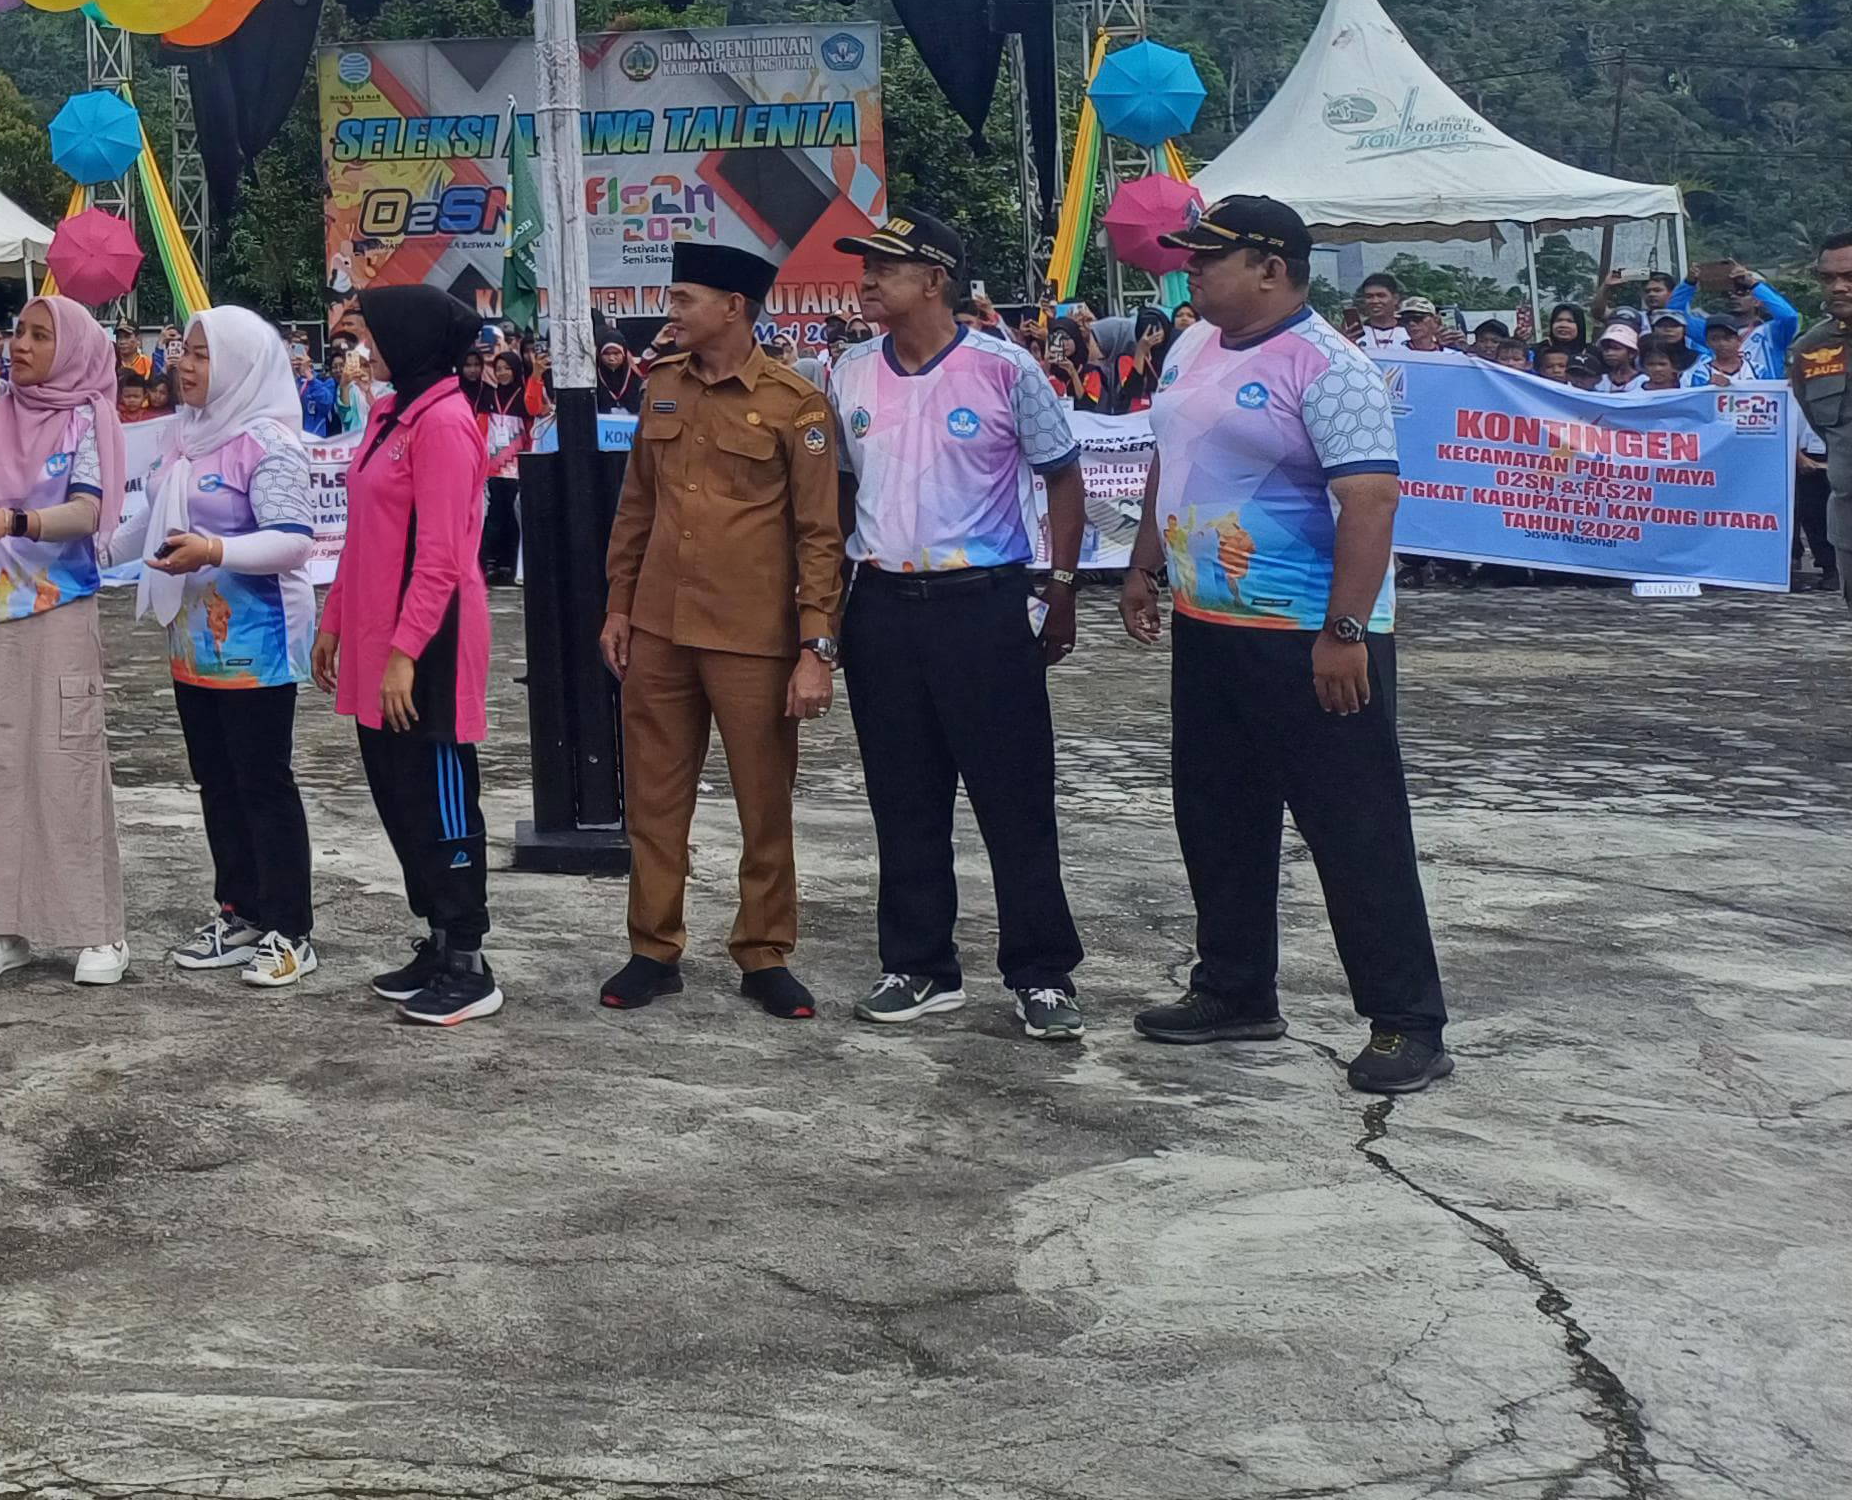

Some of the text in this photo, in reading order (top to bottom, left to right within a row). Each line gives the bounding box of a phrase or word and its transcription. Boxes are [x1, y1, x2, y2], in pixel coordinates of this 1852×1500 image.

[661, 36, 813, 61] DINAS PENDIDIKAN
[661, 56, 816, 76] KABUPATEN KAYONG UTARA
[333, 115, 499, 162] SELEKSI
[664, 101, 858, 152] TALENTA
[623, 217, 716, 241] 2024
[622, 244, 658, 254] Festival
[622, 255, 643, 264] Seni
[764, 281, 862, 315] UTARA
[1456, 409, 1700, 463] KONTINGEN
[1437, 443, 1716, 488] KECAMATAN PULAU MAYA
[1561, 481, 1576, 494] &
[1583, 480, 1653, 502] FLS2N
[1473, 487, 1601, 517] KABUPATEN
[1606, 503, 1698, 527] KAYONG
[1702, 510, 1779, 532] UTARA
[1502, 511, 1643, 542] TAHUN 2024
[1524, 529, 1617, 548] Siswa Nasional
